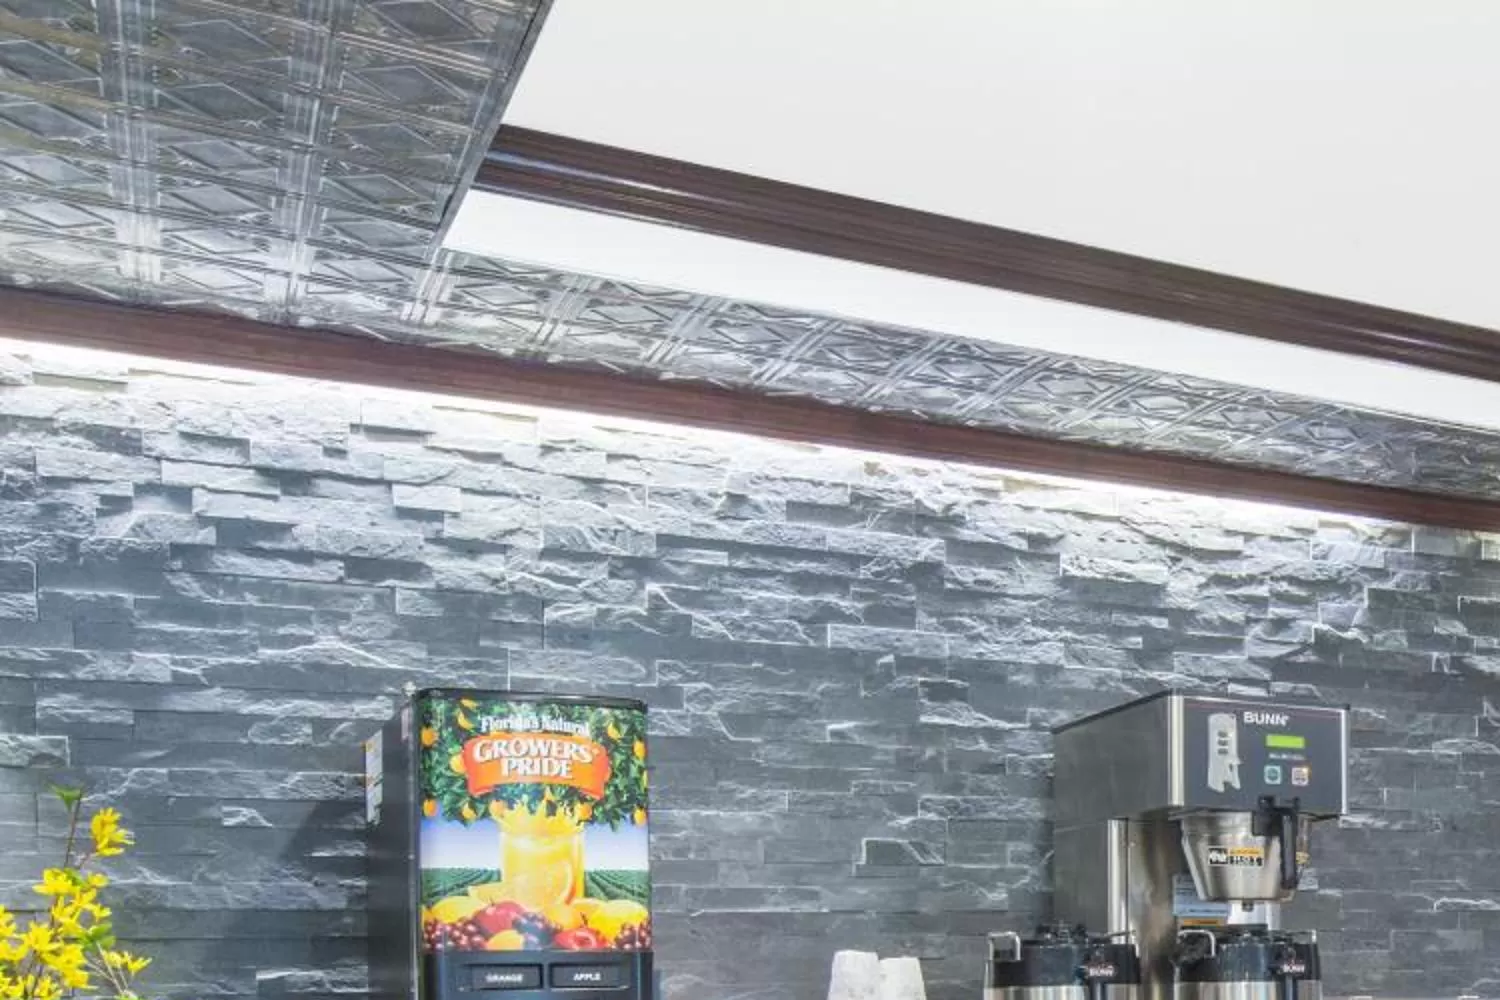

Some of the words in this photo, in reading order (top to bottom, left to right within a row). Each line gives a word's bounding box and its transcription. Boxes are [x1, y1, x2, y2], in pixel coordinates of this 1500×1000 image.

[541, 715, 590, 737] Natural
[1243, 711, 1288, 725] BUNN
[472, 737, 593, 763] GROWERS
[501, 757, 573, 778] PRIDE
[573, 972, 601, 981] APPLE
